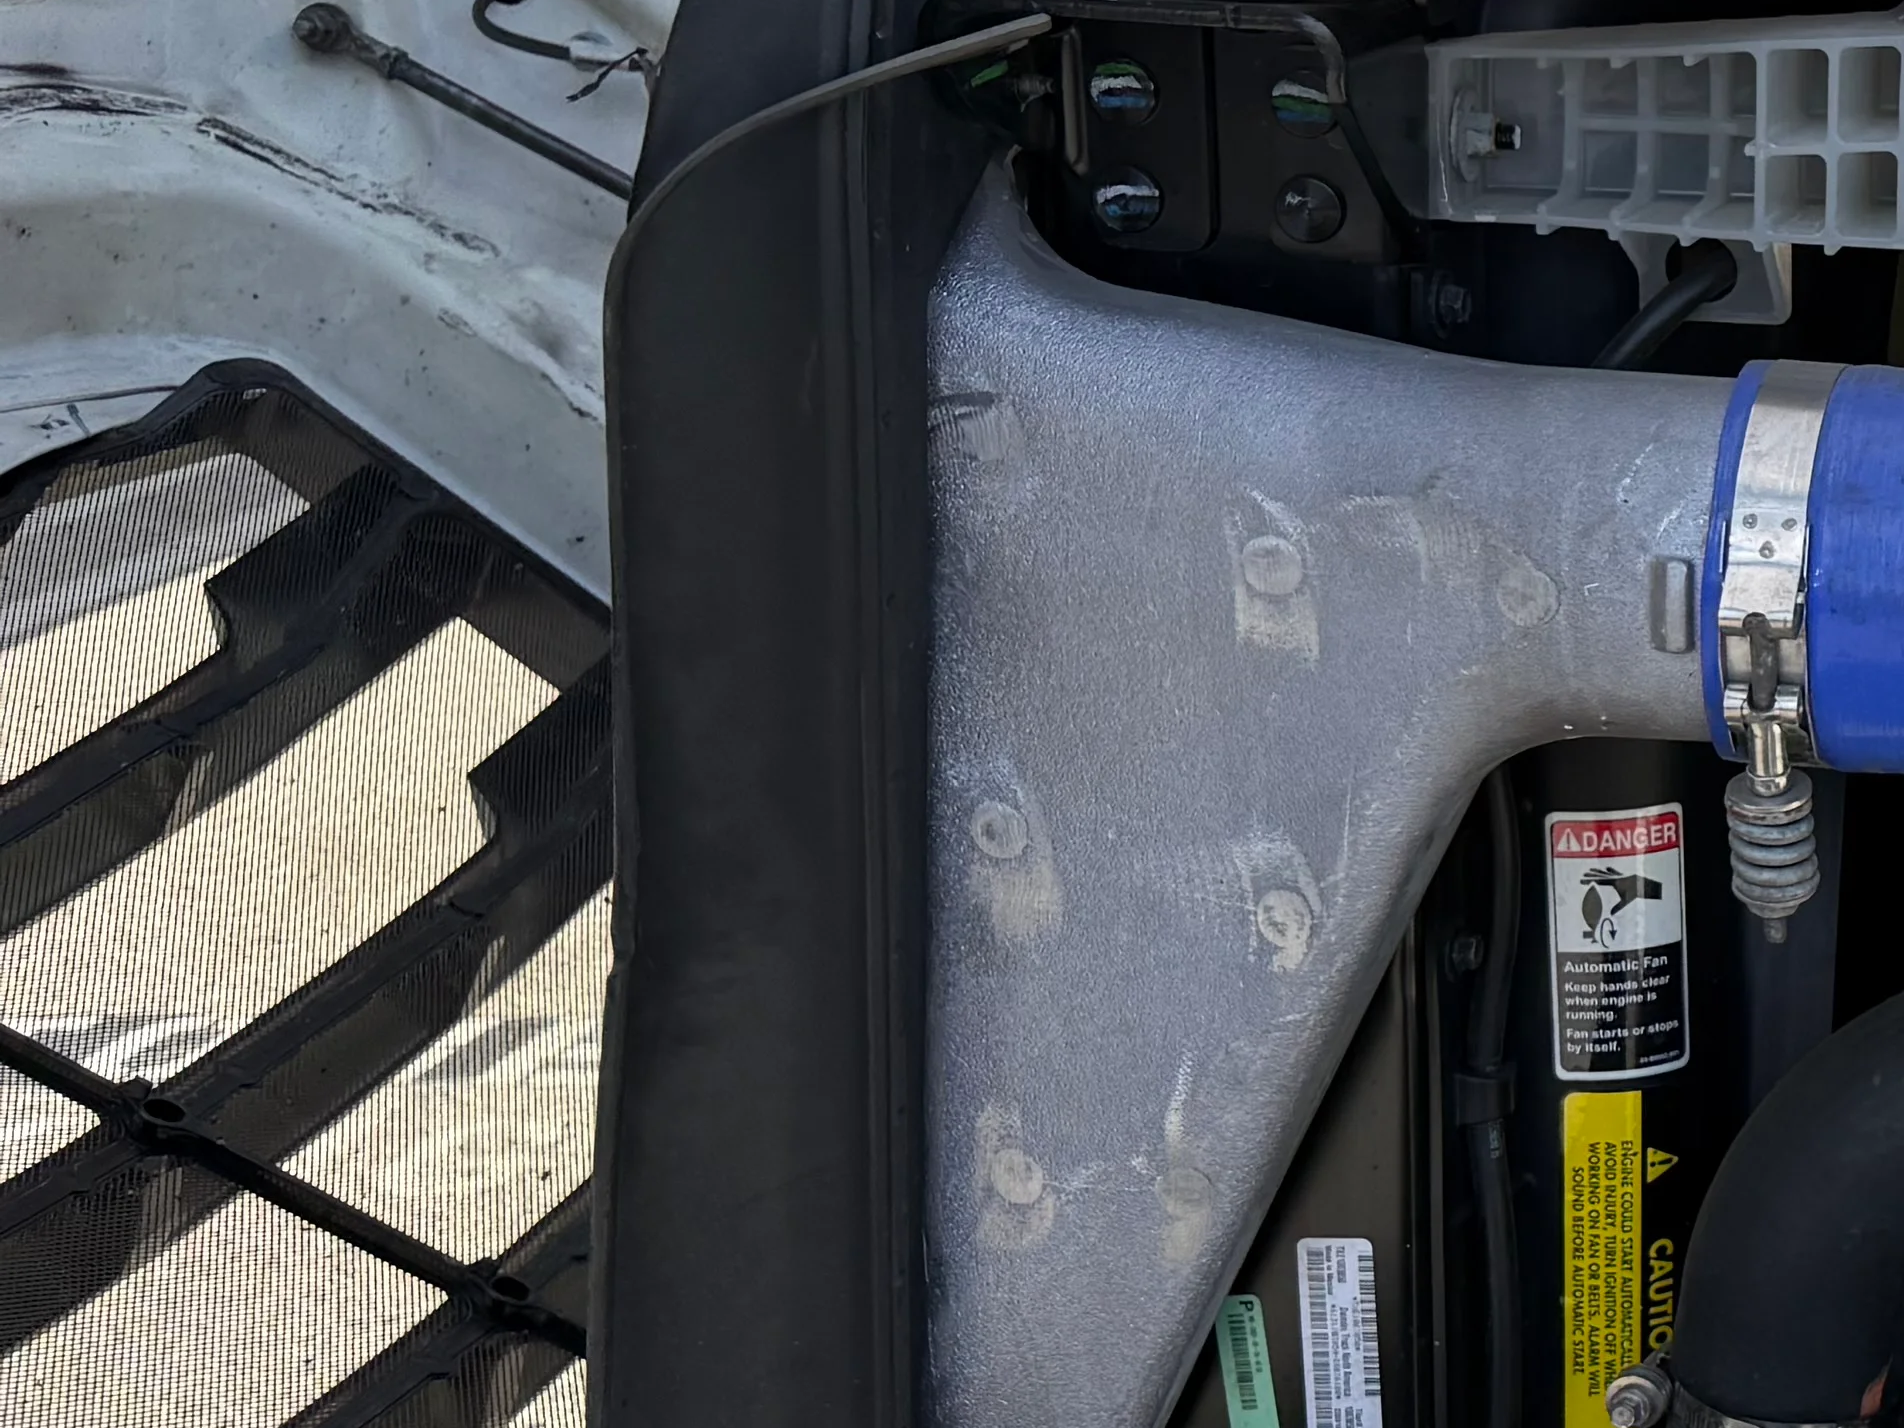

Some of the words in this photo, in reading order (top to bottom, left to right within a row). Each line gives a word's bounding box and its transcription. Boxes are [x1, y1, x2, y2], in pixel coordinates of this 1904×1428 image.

[1582, 822, 1677, 853] DANGER
[1563, 958, 1639, 975] Automatic
[1643, 955, 1668, 969] Fan
[1564, 981, 1597, 995] Keep
[1600, 978, 1638, 992] hands
[1641, 974, 1671, 988] clear
[1565, 996, 1598, 1007] when
[1601, 992, 1644, 1007] engine
[1646, 990, 1658, 1002] is
[1565, 1009, 1618, 1021] running.
[1566, 1028, 1589, 1040] Fan
[1592, 1026, 1630, 1038] starts
[1632, 1025, 1646, 1036] or
[1648, 1019, 1679, 1035] stops
[1566, 1041, 1582, 1054] by
[1585, 1040, 1621, 1053] itself.
[1587, 1142, 1601, 1206] WORKING
[1603, 1141, 1617, 1180] AVOID
[1620, 1140, 1634, 1188] ENGINE
[1571, 1166, 1585, 1212] SOUND
[1587, 1209, 1601, 1230] ON
[1603, 1184, 1617, 1232] INJURY,
[1620, 1192, 1634, 1234] COULD
[1571, 1215, 1585, 1261] BEFORE
[1587, 1234, 1601, 1259] FAN
[1603, 1236, 1617, 1268] TURN
[1587, 1262, 1601, 1281] OR
[1620, 1238, 1634, 1274] START
[1239, 1300, 1253, 1313] P
[1571, 1264, 1585, 1336] AUTOMATIC
[1587, 1284, 1601, 1321] BELTS.
[1603, 1271, 1617, 1329] IGNITION
[1648, 1238, 1675, 1351] CAUTIO
[1571, 1340, 1585, 1376] START.
[1587, 1324, 1601, 1367] ALARM
[1603, 1333, 1617, 1356] OFF
[1587, 1370, 1601, 1398] WILL
